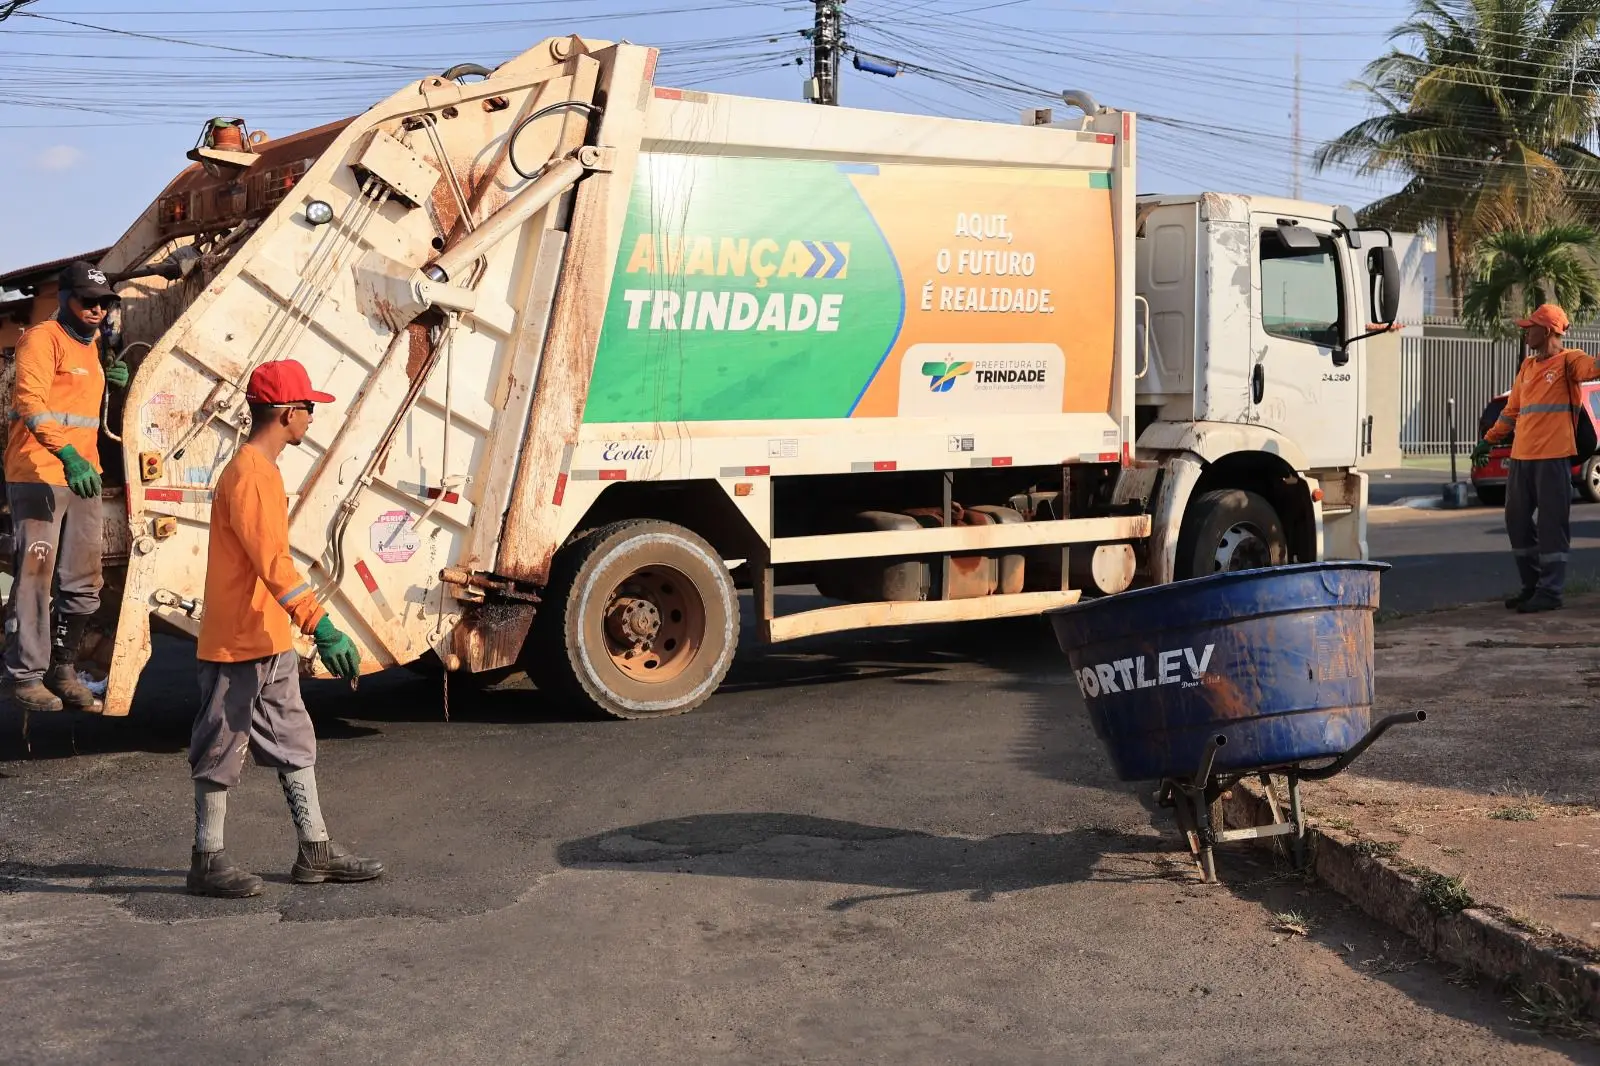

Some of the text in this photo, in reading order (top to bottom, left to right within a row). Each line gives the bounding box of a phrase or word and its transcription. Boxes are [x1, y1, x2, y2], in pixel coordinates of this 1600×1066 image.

[955, 212, 1013, 244] AQUI,
[626, 233, 805, 289] AVANÇA
[936, 248, 1036, 276] O FUTURO
[623, 289, 844, 331] TRINDADE
[921, 279, 1055, 313] É REALIDADE.
[975, 360, 1048, 369] PREFEITURA DE
[975, 370, 1046, 383] TRINDADE
[602, 441, 653, 461] Ecolix
[1075, 643, 1215, 700] FORTLEV
